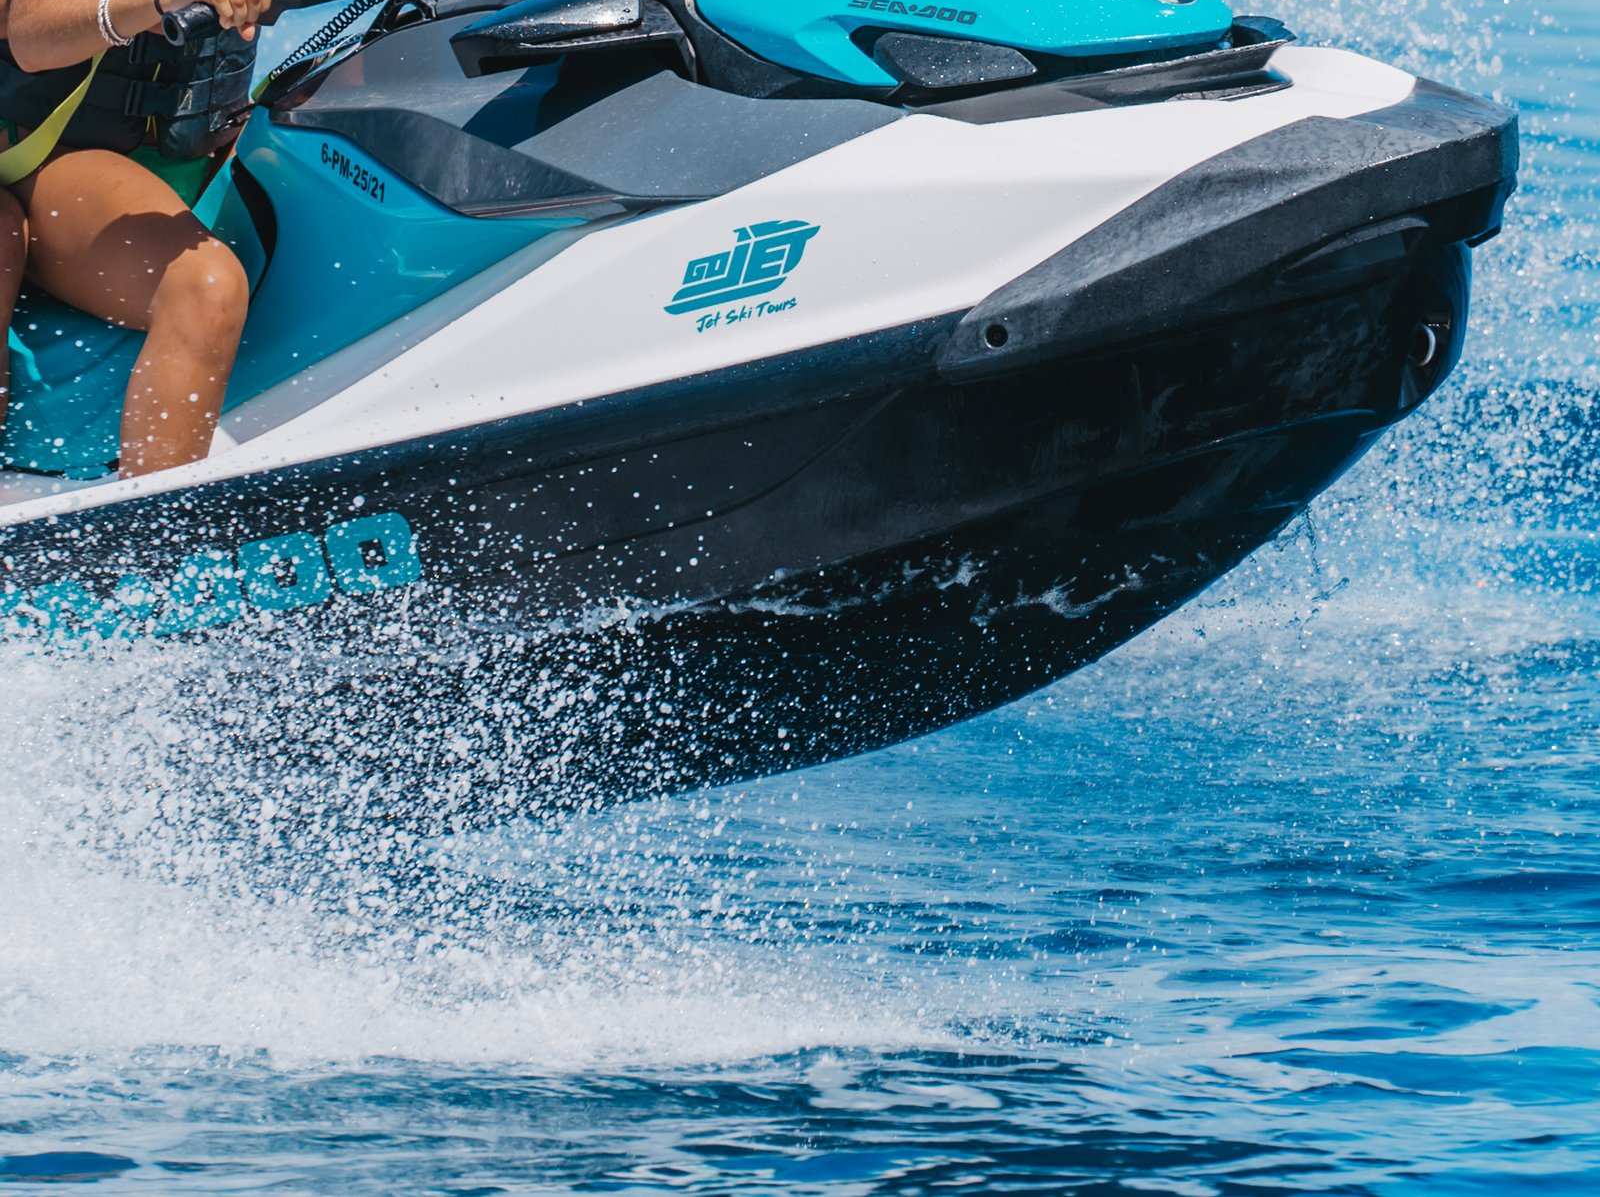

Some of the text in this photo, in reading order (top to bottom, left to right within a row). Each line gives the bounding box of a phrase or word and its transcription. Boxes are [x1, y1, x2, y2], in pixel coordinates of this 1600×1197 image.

[321, 142, 385, 203] 6-PM-25/21
[696, 297, 798, 333] Jet Ski Tours
